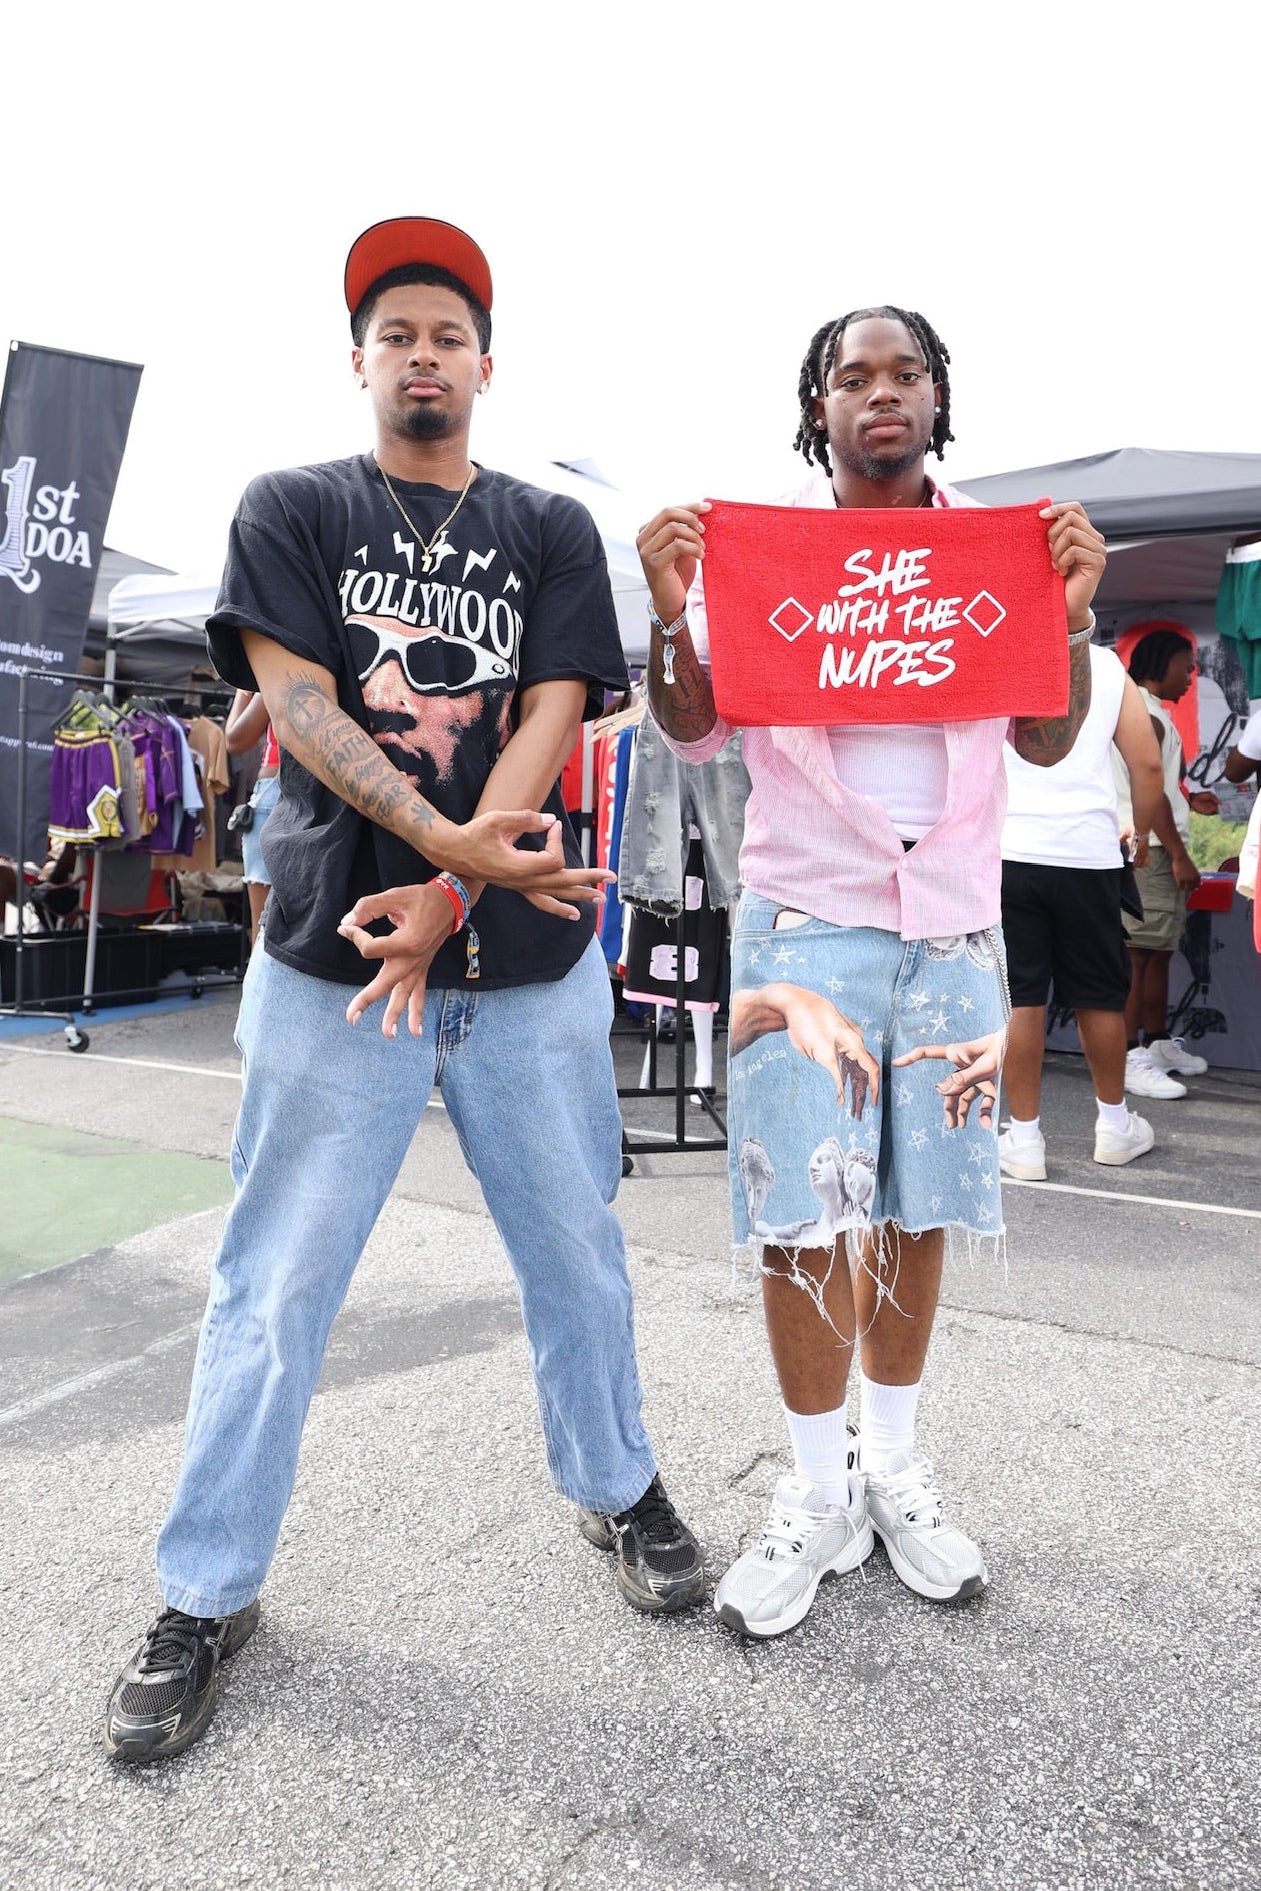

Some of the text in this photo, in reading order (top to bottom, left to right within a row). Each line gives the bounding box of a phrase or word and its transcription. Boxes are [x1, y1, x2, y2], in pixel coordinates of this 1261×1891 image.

[0, 456, 80, 574] 1st
[25, 522, 92, 568] DOA
[838, 548, 932, 597] SHE
[817, 595, 963, 636] WITH THE
[818, 638, 956, 689] NUPES
